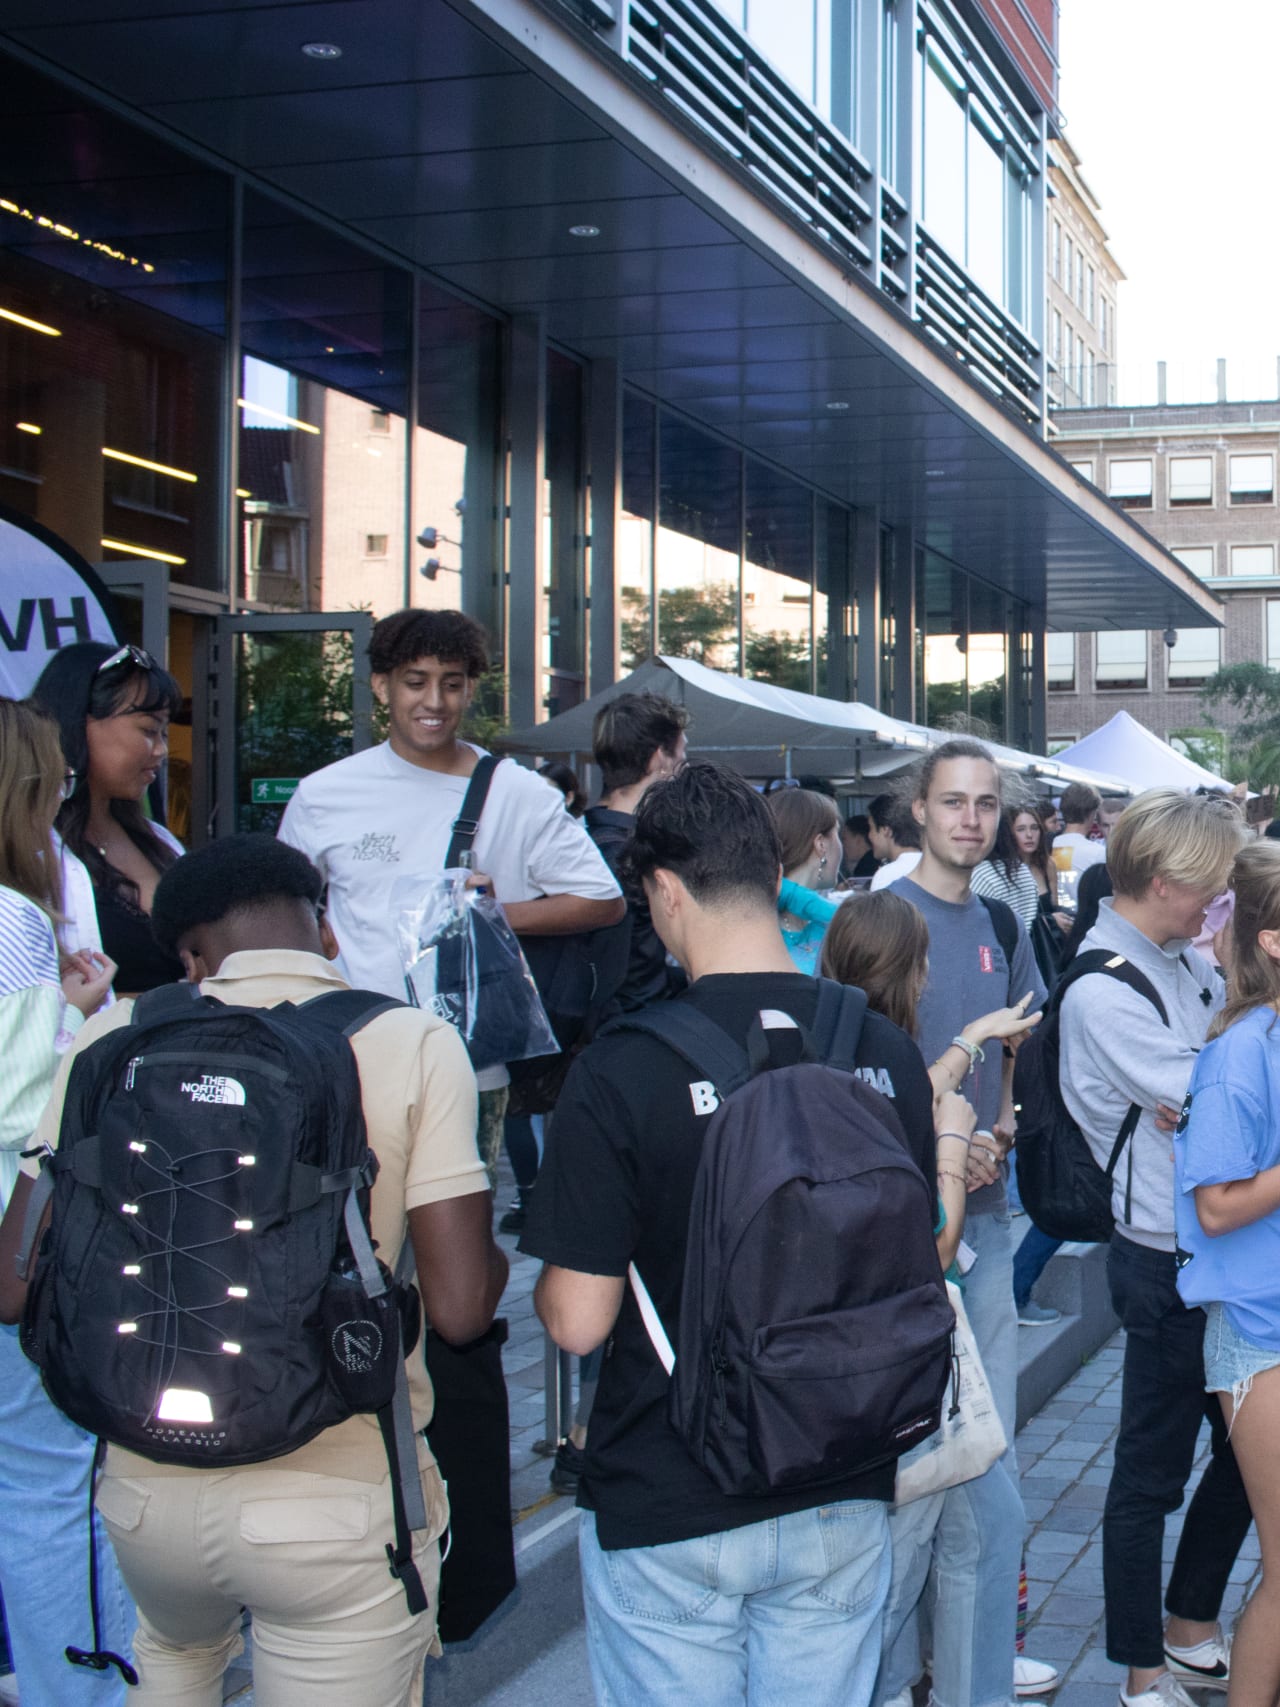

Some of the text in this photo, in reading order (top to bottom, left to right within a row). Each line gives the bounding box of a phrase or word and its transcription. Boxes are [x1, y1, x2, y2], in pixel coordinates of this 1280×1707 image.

[201, 1075, 226, 1087] THE
[181, 1082, 224, 1095] NORTH
[191, 1093, 223, 1103] FACE
